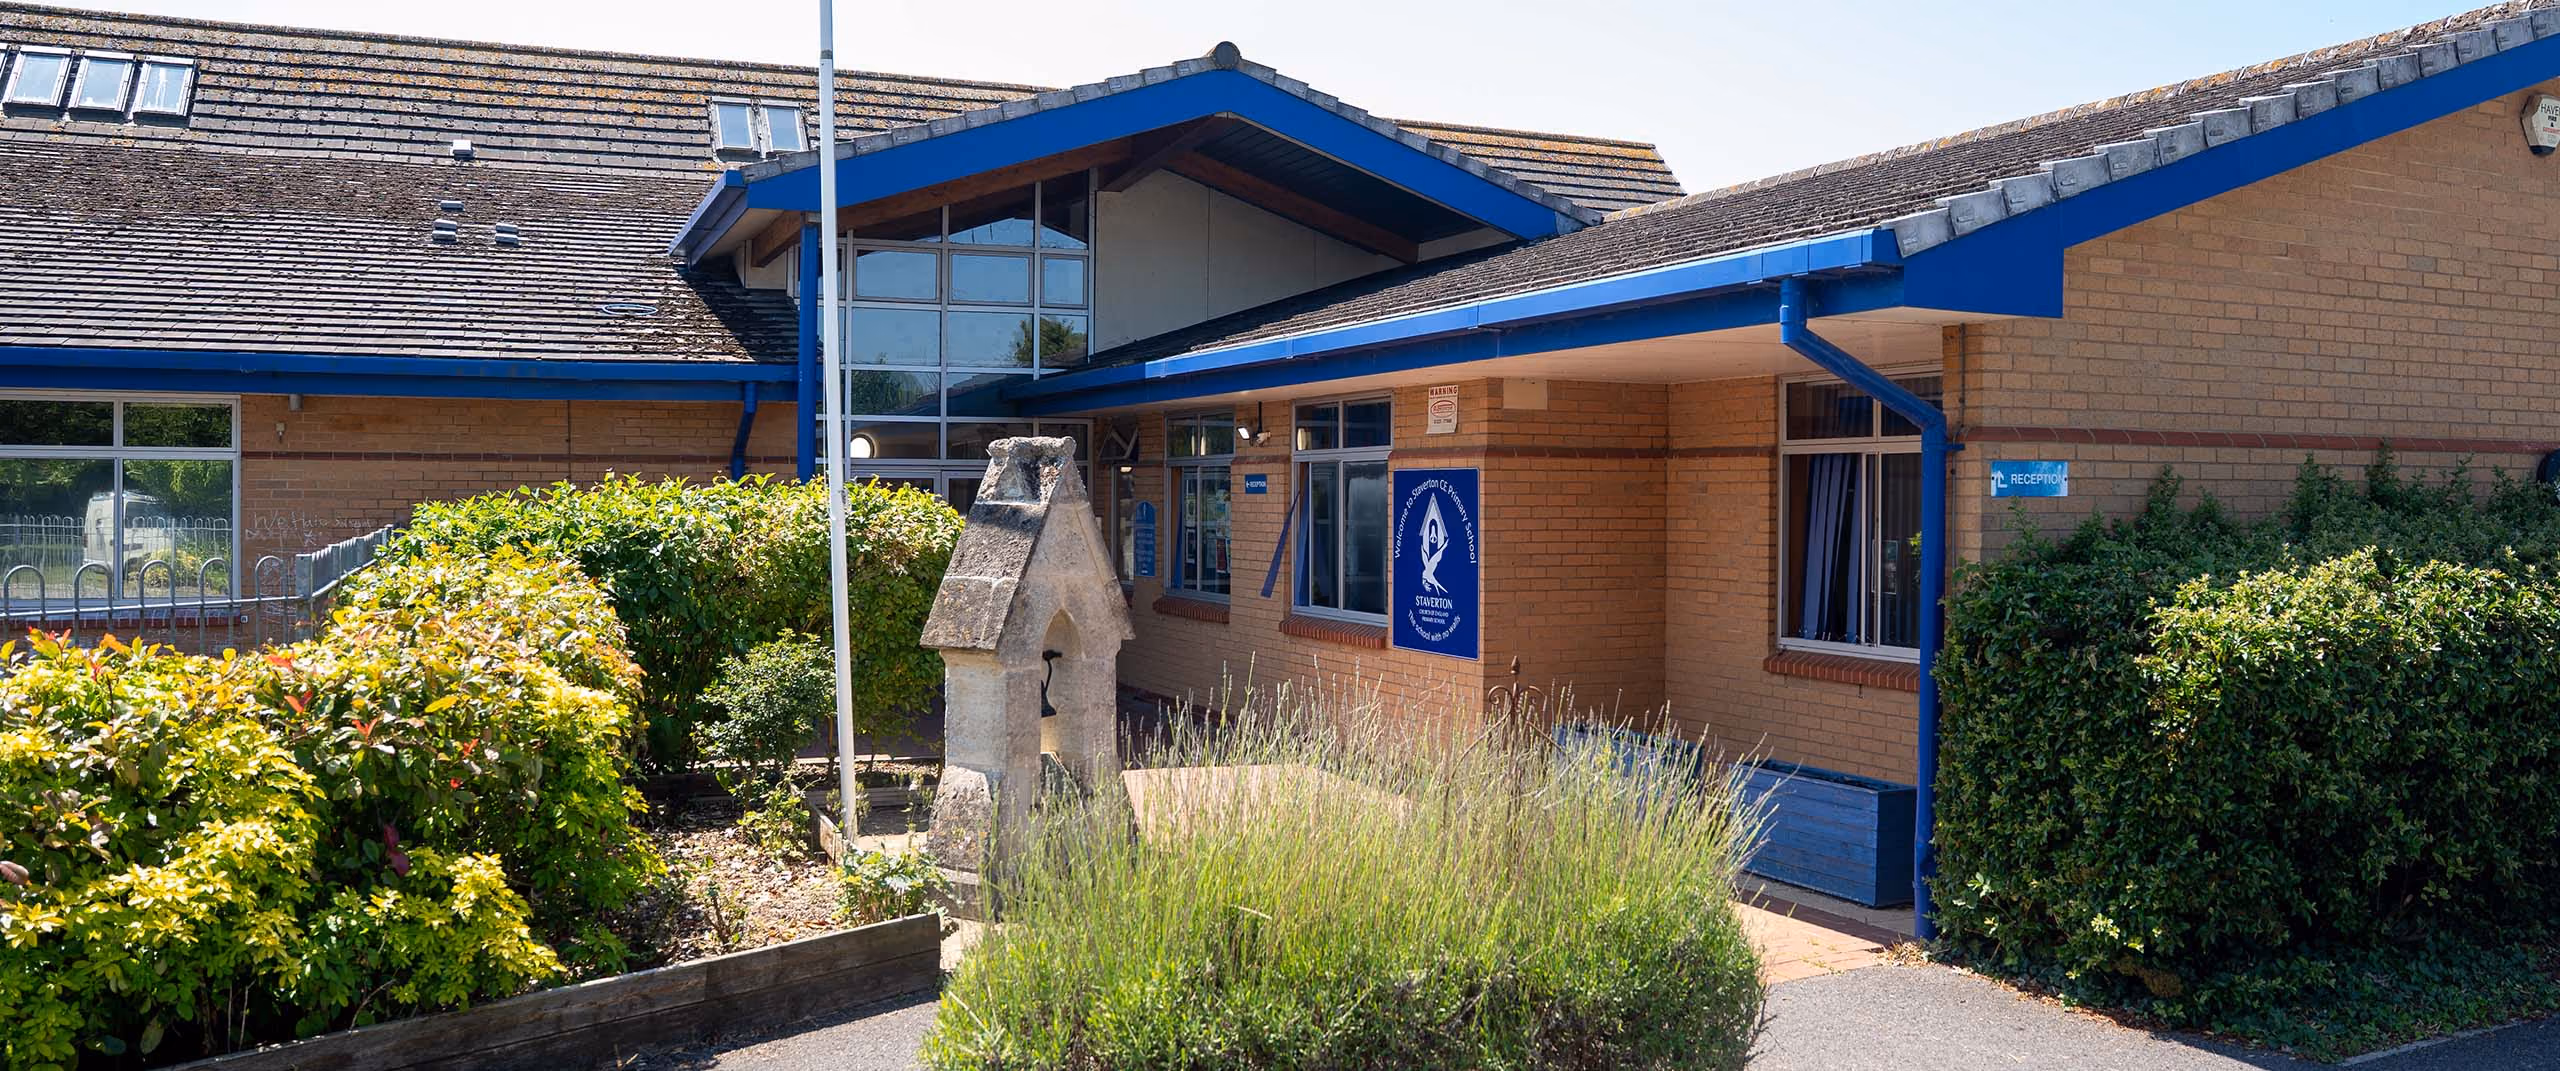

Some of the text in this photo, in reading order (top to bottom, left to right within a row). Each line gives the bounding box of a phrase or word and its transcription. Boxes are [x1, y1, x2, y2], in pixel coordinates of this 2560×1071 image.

[2540, 103, 2560, 116] HAVE
[1429, 386, 1457, 396] WARNING
[2010, 473, 2064, 485] RECEPTION
[1394, 478, 1477, 564] Welcome to Staverton CE Primary School
[1415, 595, 1453, 609] STAVERTON
[1408, 609, 1416, 627] The
[1415, 624, 1431, 640] school
[1430, 632, 1442, 641] with
[1442, 630, 1450, 639] no
